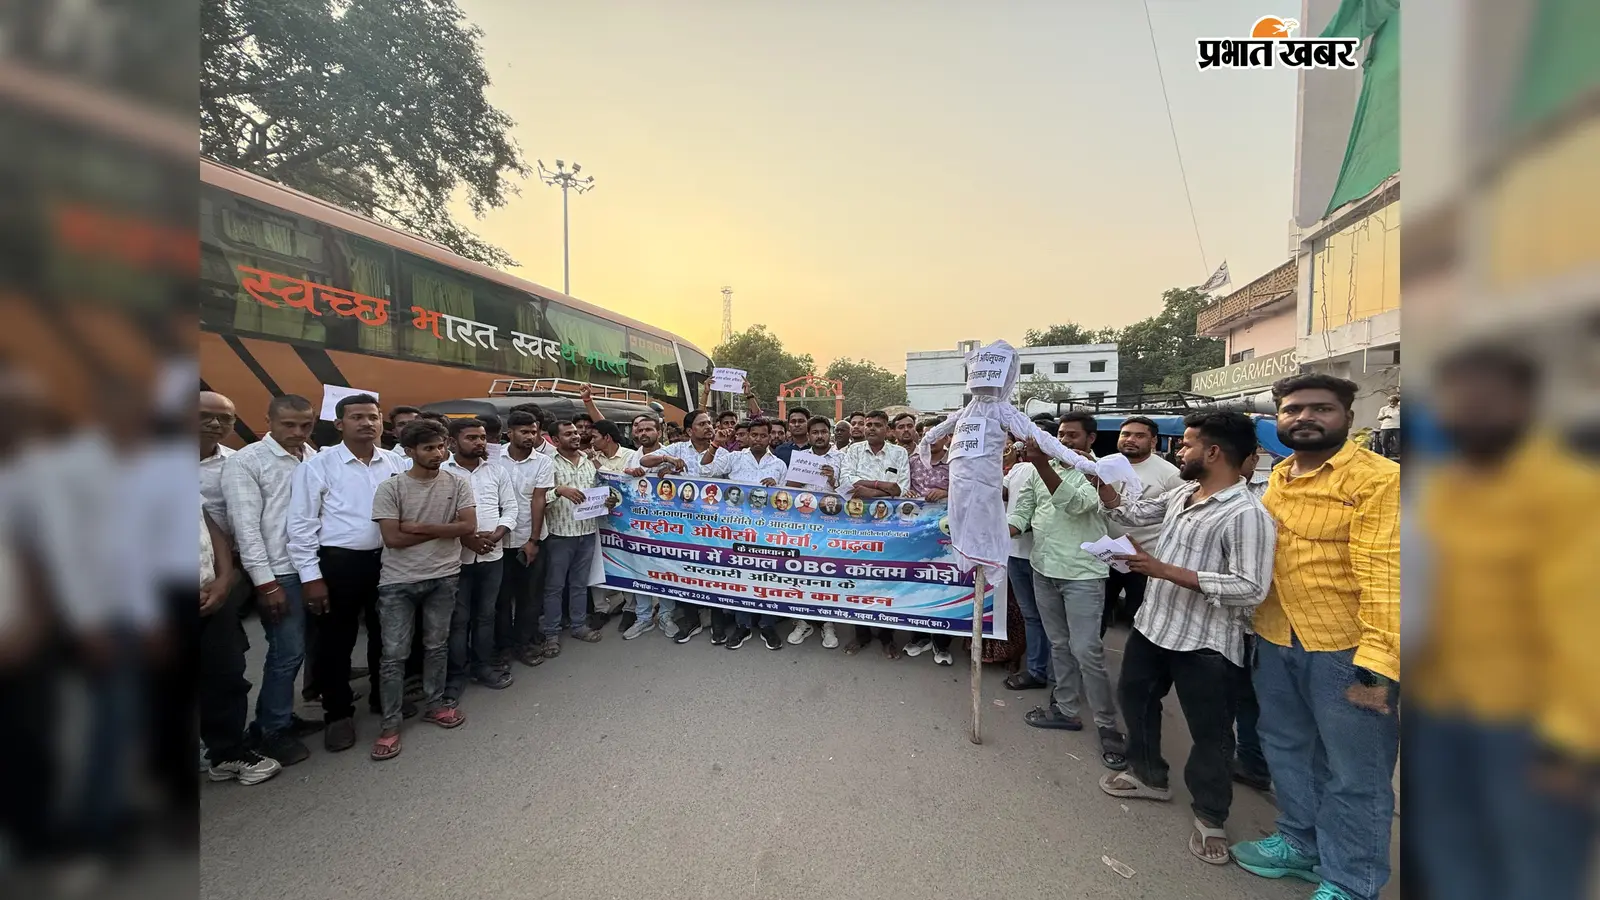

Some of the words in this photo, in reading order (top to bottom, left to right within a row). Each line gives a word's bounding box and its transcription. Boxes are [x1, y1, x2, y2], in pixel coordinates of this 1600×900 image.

[237, 265, 390, 326] स्वच्छ
[411, 305, 498, 350] भारत
[511, 330, 578, 367] स्वस्थ
[585, 349, 629, 377] भारत
[1193, 370, 1228, 392] ANSARI
[1231, 352, 1298, 384] GARMENTS
[630, 518, 684, 535] राष्ट्रीय
[691, 523, 757, 543] ओबीसी
[765, 531, 818, 550] मोर्चा,
[827, 538, 885, 553] गढ़वा
[651, 509, 693, 520] जनगणना
[695, 511, 718, 523] संघर्ष
[721, 514, 752, 526] समिति
[755, 517, 765, 527] के
[808, 524, 824, 532] पर
[627, 540, 700, 561] जनगणना
[707, 548, 720, 563] में
[728, 554, 778, 570] अगल
[785, 559, 837, 574] OBC
[845, 563, 907, 579] कॉलम
[913, 564, 960, 584] जोड़ो
[787, 549, 796, 557] में
[647, 569, 748, 593] प्रतीकात्मक
[753, 585, 805, 599] पुतले
[811, 591, 840, 602] का
[845, 595, 894, 607] दहन
[683, 564, 741, 579] सरकारी
[748, 572, 831, 588] अधिसूचना
[838, 579, 856, 590] के
[668, 588, 690, 598] अक्टूबर
[691, 592, 711, 600] 2026
[741, 599, 756, 607] शाम
[766, 602, 779, 610] बजे
[817, 606, 832, 616] रंका
